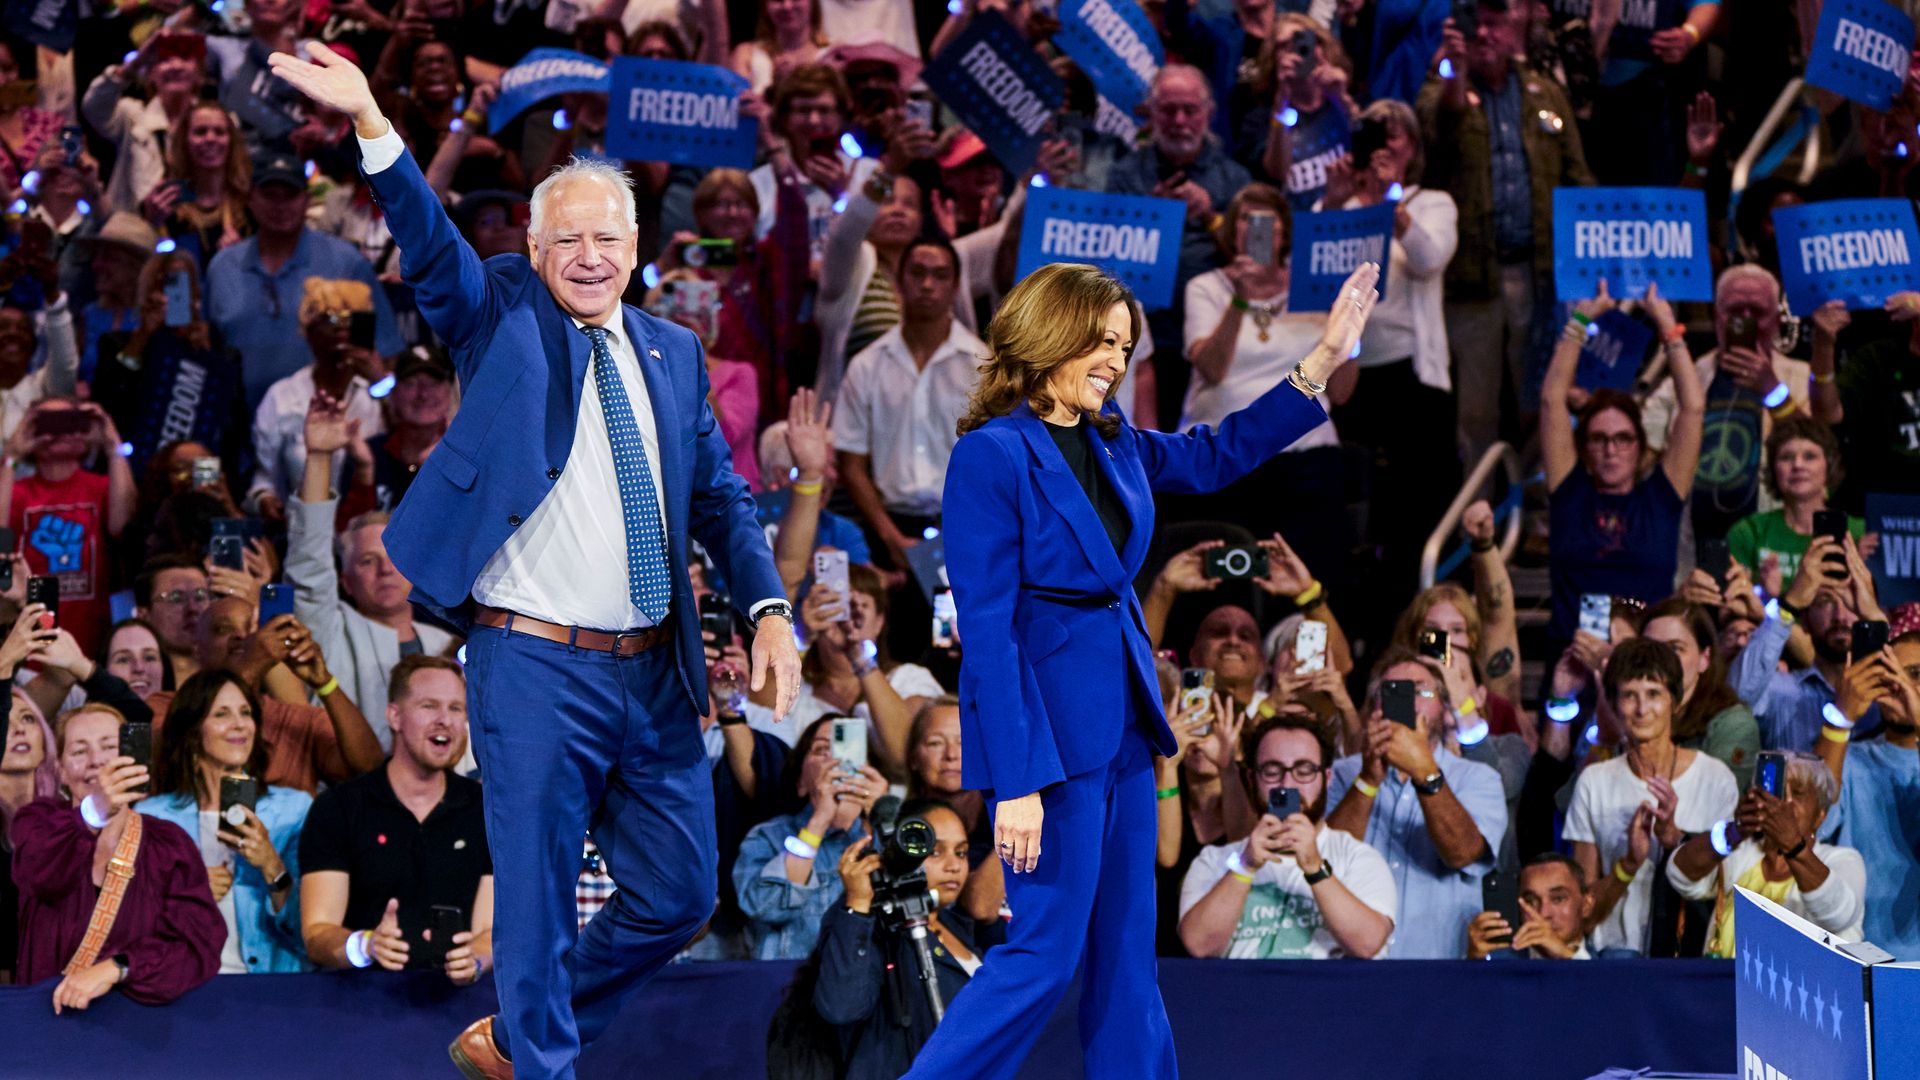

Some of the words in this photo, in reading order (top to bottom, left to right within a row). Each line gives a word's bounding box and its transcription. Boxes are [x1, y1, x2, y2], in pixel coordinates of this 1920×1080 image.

[501, 57, 608, 95] FREEDOM
[960, 39, 1053, 136] FREEDOM
[627, 87, 740, 131] FREEDOM
[1041, 217, 1161, 265] FREEDOM
[1574, 219, 1693, 260] FREEDOM
[1799, 228, 1911, 275] FREEDOM
